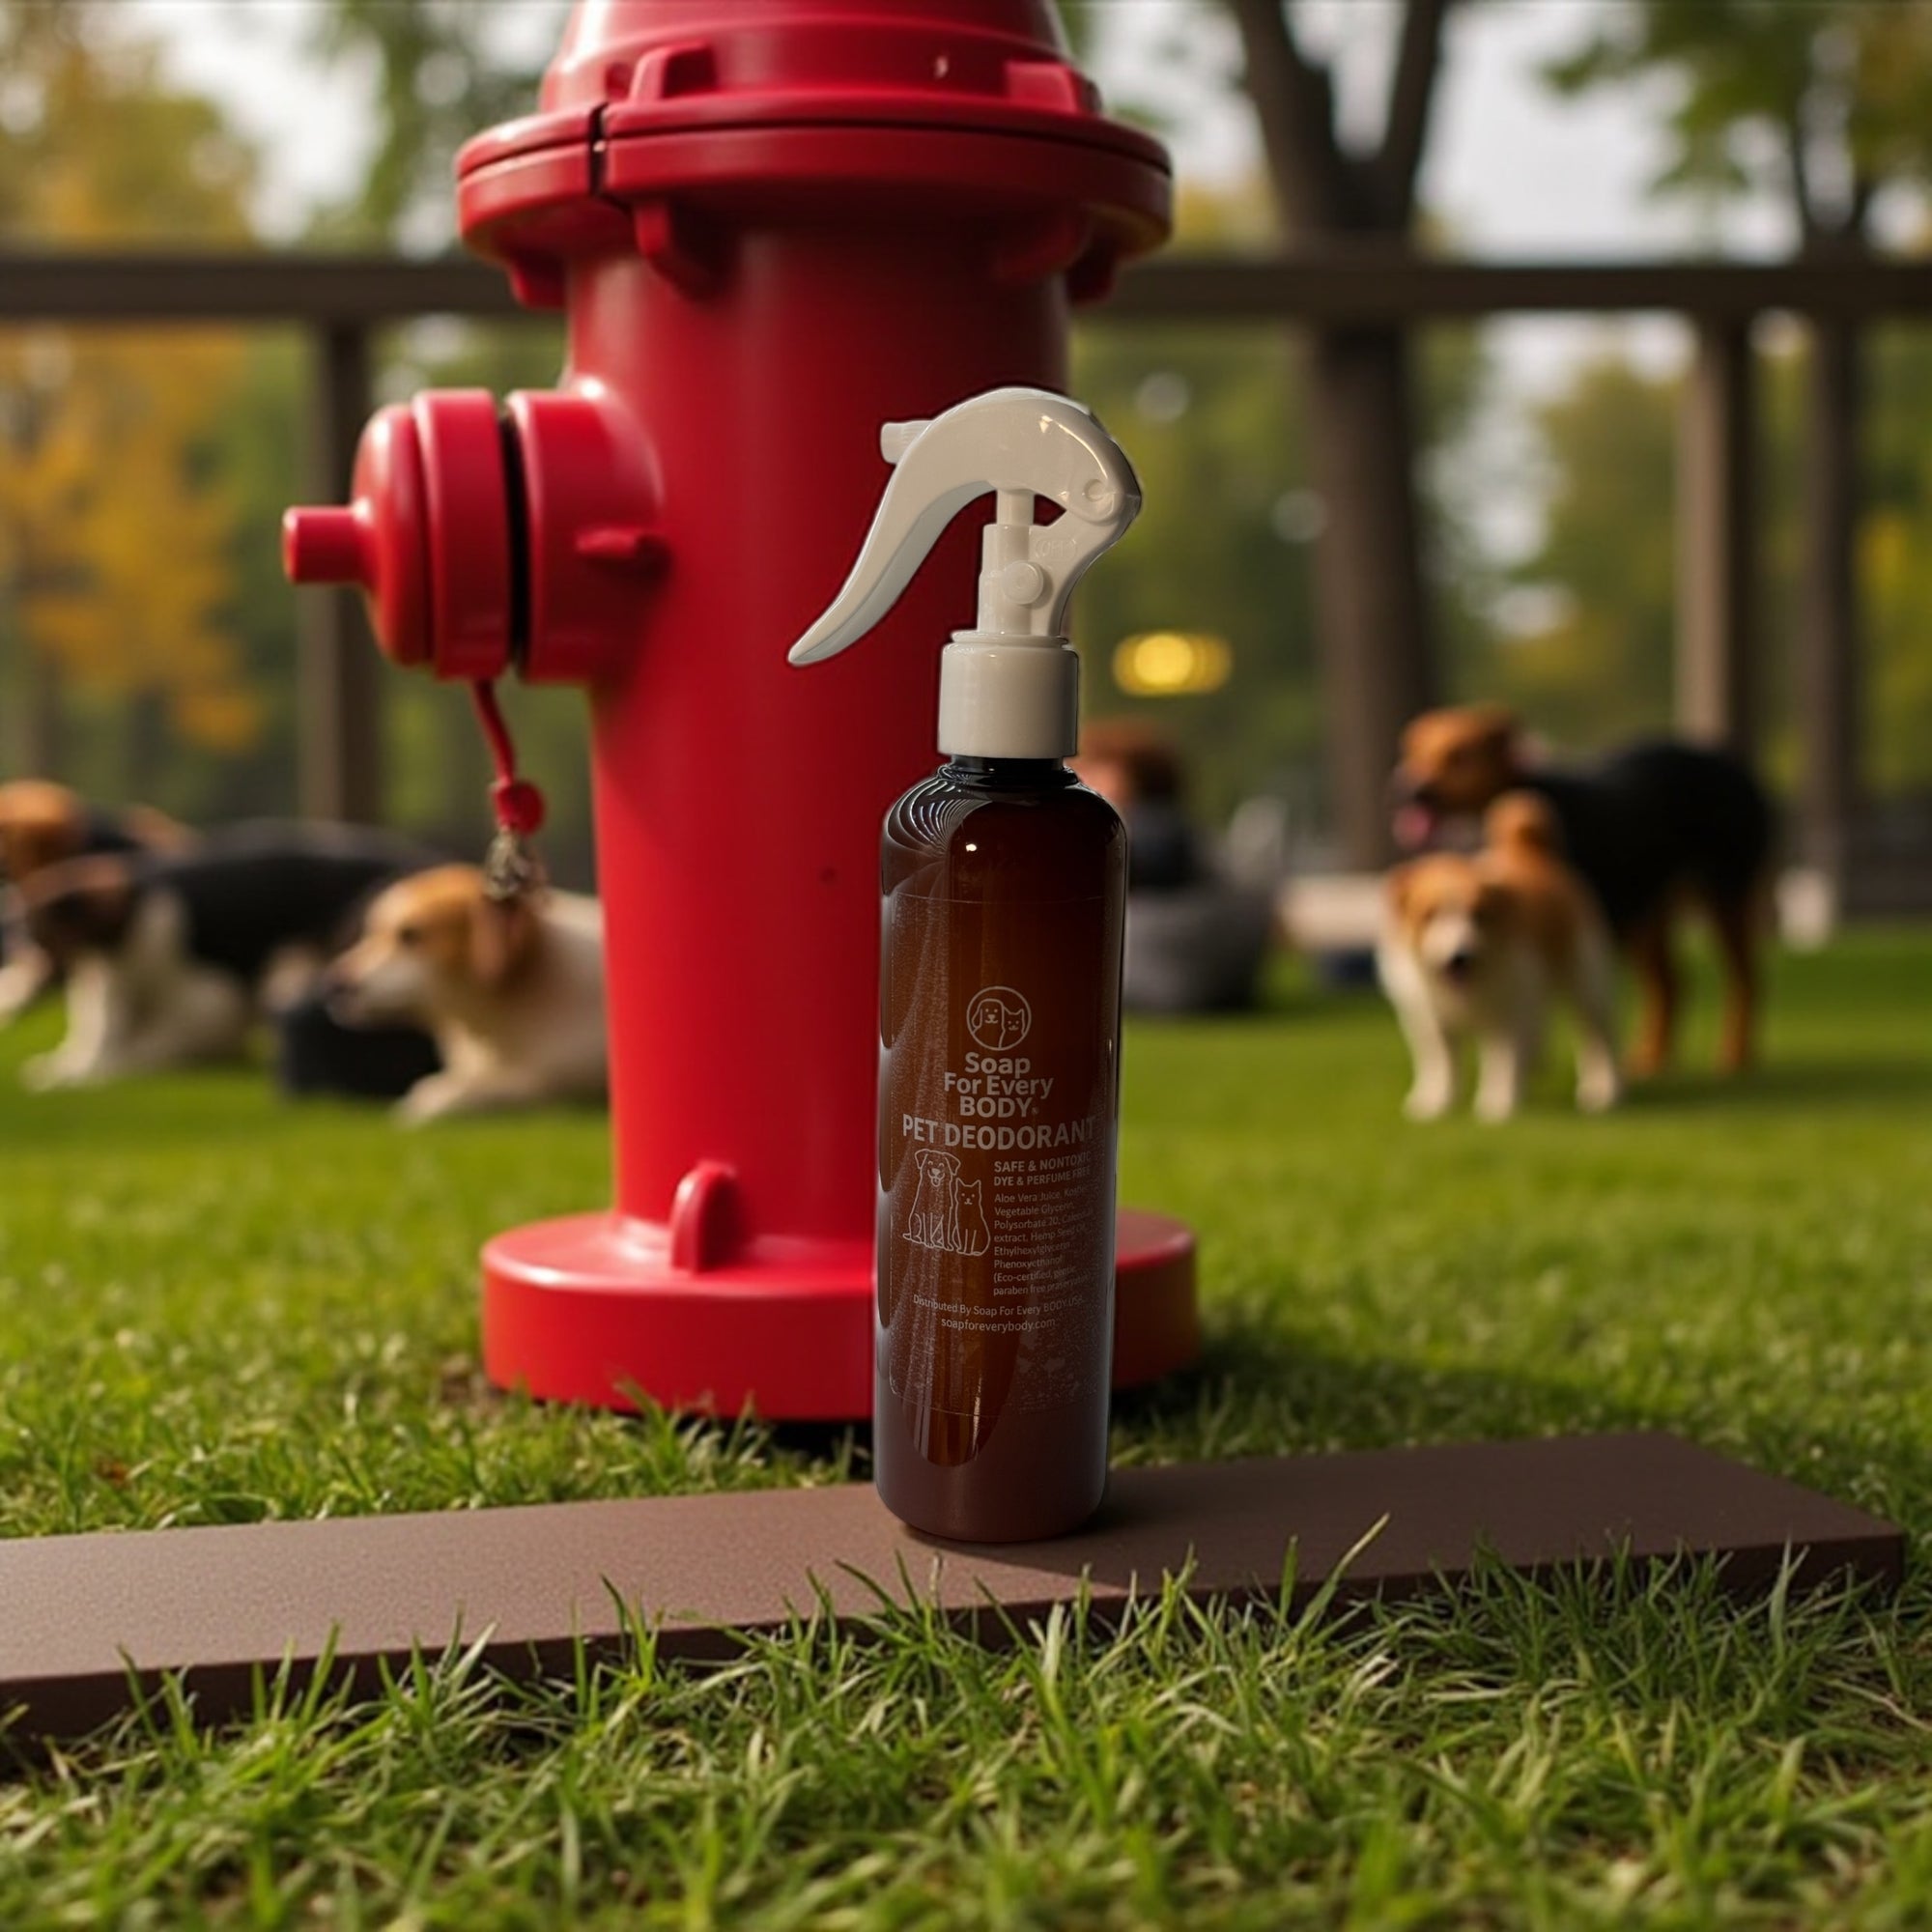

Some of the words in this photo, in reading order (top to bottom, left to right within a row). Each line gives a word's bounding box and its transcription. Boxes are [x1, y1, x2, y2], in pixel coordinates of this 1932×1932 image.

[965, 1052, 1031, 1079] Soap
[944, 1072, 981, 1094] For
[986, 1075, 1054, 1100] Every
[903, 1114, 938, 1144] PET
[945, 1116, 1096, 1151] DEODORANT
[994, 1160, 1025, 1173] SAFE
[1028, 1160, 1037, 1172] &
[1039, 1151, 1092, 1171] NONTOXIC
[993, 1176, 1014, 1186] DYE
[1016, 1176, 1024, 1186] &
[1027, 1171, 1070, 1185] PERFUME
[1072, 1166, 1091, 1179] FREE
[994, 1193, 1015, 1203] Aloe
[1017, 1193, 1037, 1203] Vera
[994, 1206, 1039, 1218] Vegetable
[994, 1219, 1046, 1231] Polysorbate
[1030, 1232, 1056, 1242] Hemp
[993, 1286, 1029, 1296] paraben
[1030, 1284, 1045, 1294] free
[913, 1293, 958, 1313] Distributed
[960, 1305, 971, 1317] By
[973, 1306, 997, 1318] Soap
[999, 1306, 1013, 1316] For
[1016, 1304, 1041, 1317] Every
[941, 1317, 1056, 1333] soapforeverybody.com
